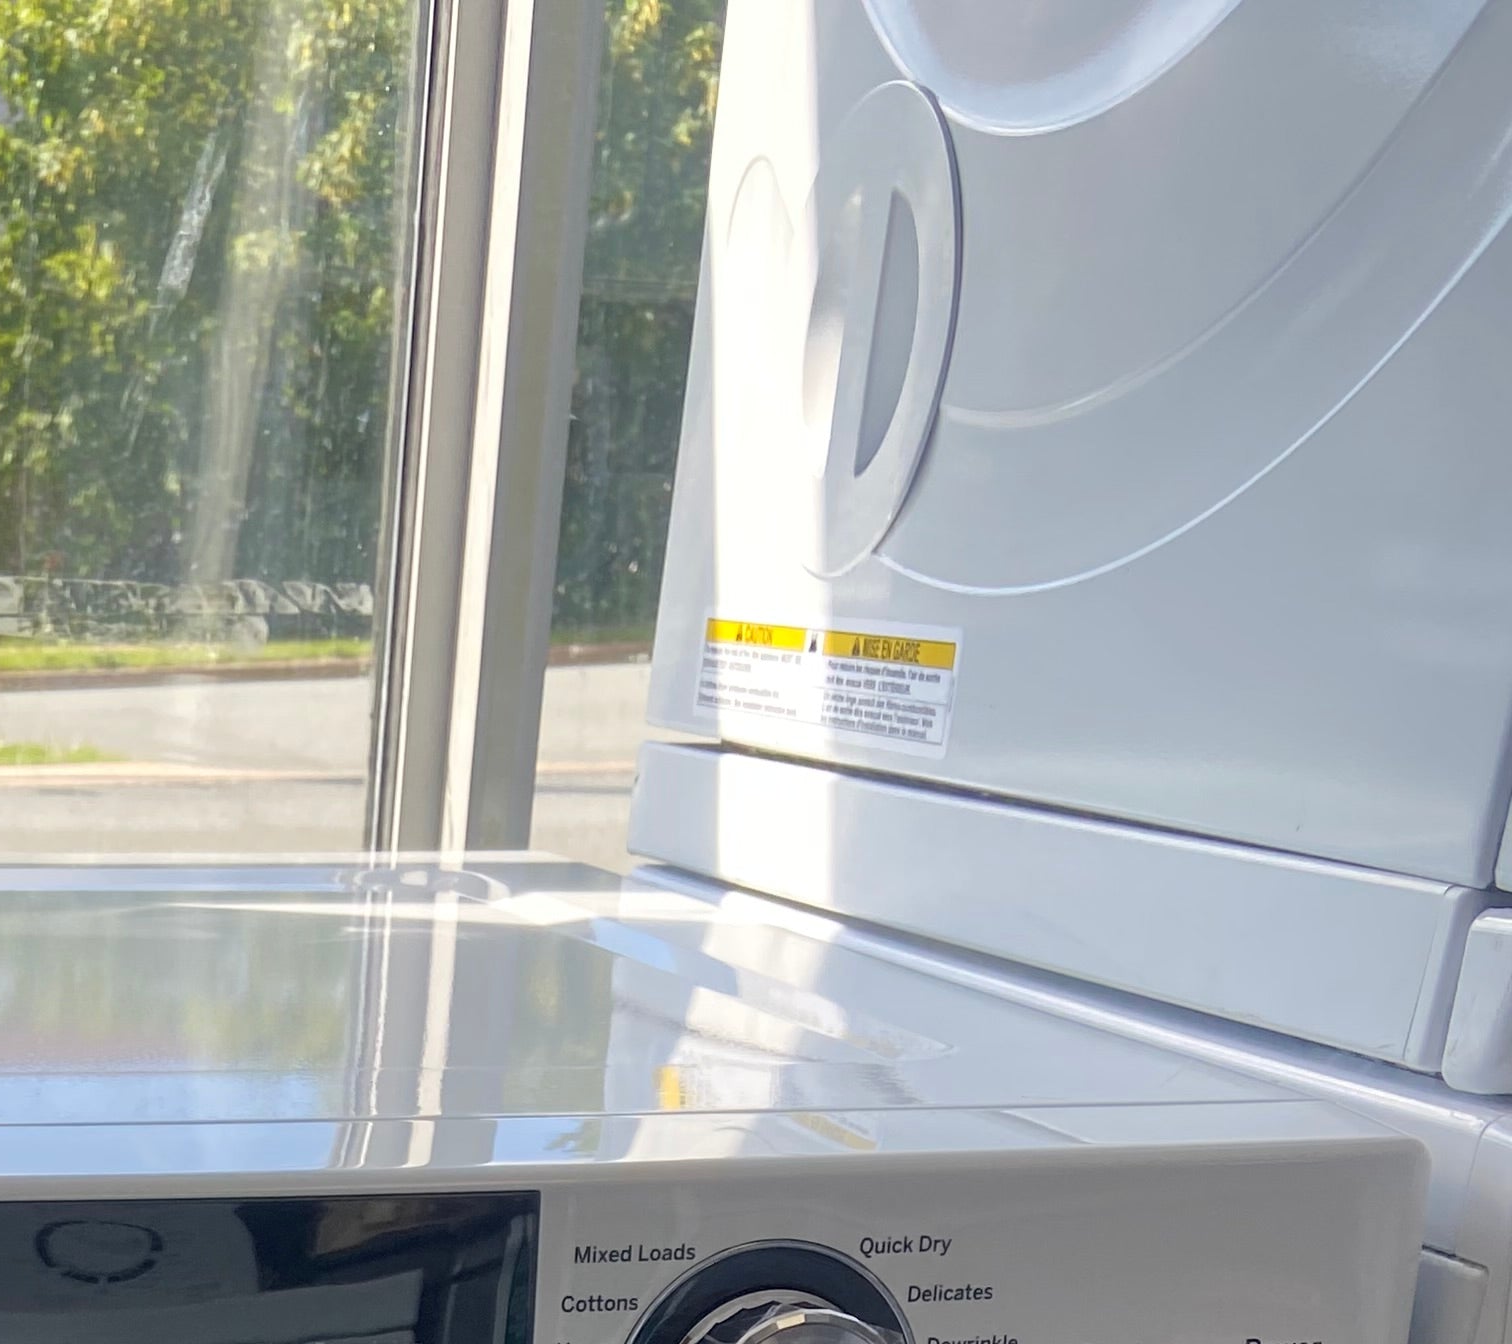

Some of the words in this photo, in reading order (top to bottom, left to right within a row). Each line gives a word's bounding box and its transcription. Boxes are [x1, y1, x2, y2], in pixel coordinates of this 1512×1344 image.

[574, 1245, 632, 1264] Mixed
[638, 1243, 696, 1262] Loads
[859, 1236, 914, 1259] Quick
[919, 1235, 953, 1257] Dry
[907, 1283, 994, 1303] Delicates
[561, 1295, 639, 1313] Cottons
